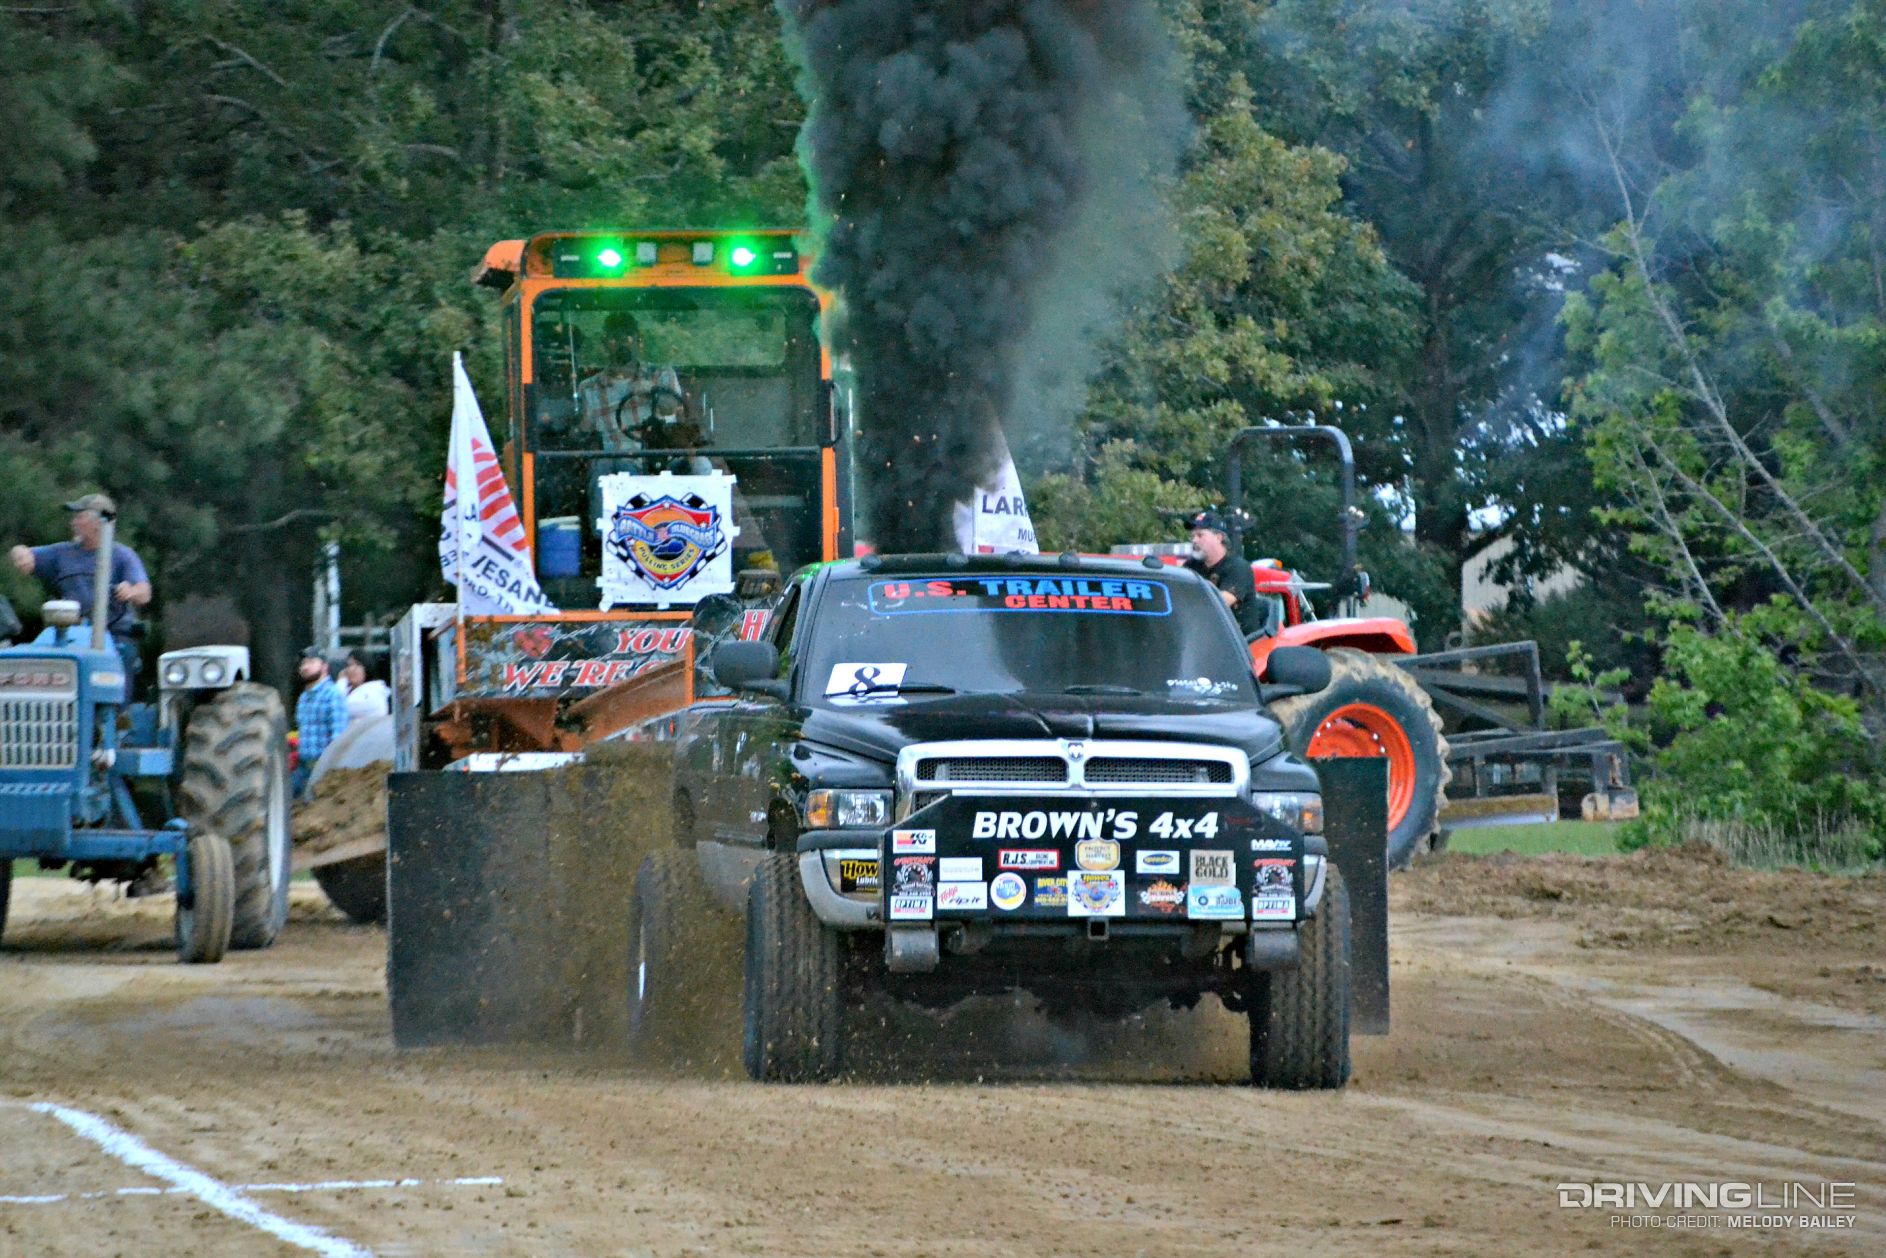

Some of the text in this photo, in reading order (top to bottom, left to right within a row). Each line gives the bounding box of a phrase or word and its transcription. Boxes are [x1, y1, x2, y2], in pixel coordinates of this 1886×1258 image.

[639, 545, 669, 571] PULLING
[883, 580, 1152, 600] U.S. TRAILER
[1004, 595, 1133, 610] CENTER
[612, 627, 694, 654] YOU
[502, 660, 634, 692] WE'RE
[848, 666, 881, 696] 8
[973, 809, 1219, 839] BROWN'S 4x4
[1195, 856, 1229, 868] BLACK
[1195, 867, 1229, 879] GOLD
